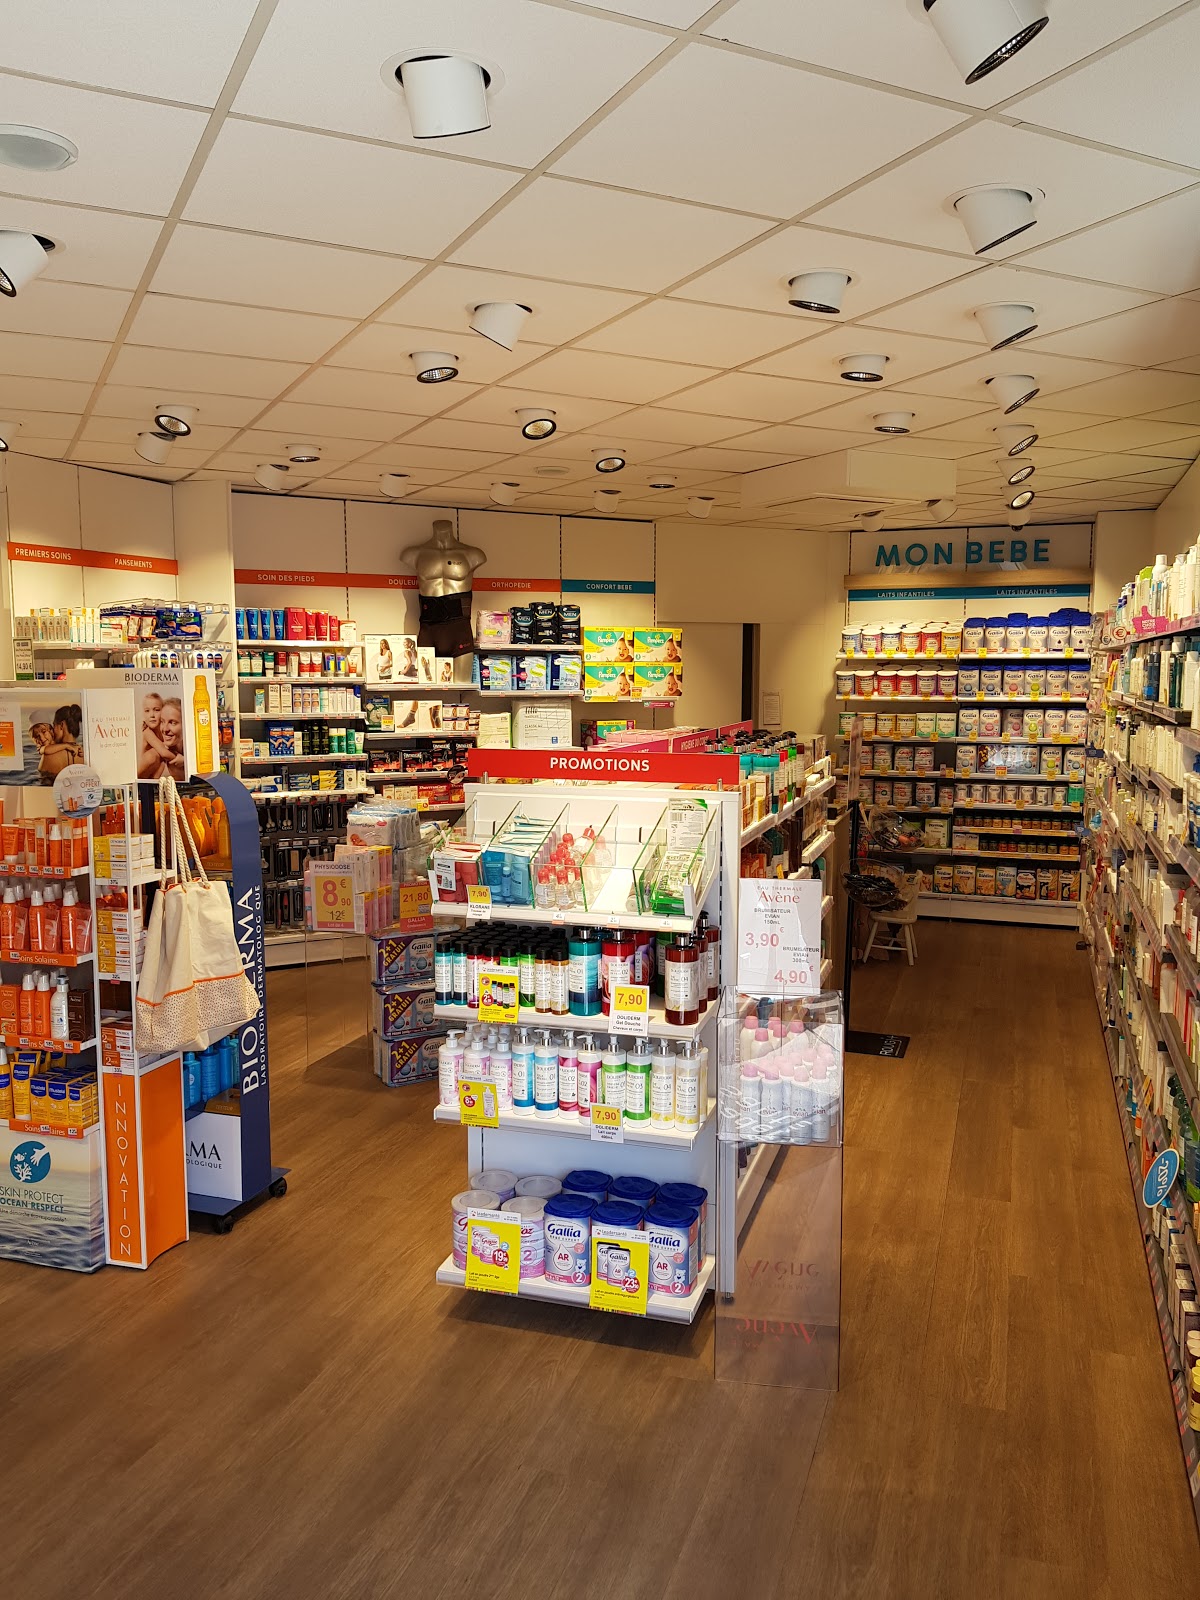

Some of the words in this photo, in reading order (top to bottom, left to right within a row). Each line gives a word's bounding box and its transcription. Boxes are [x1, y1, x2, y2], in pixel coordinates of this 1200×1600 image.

[15, 548, 49, 558] PREMIERS
[51, 551, 72, 561] SOINS
[875, 542, 952, 567] MON
[966, 539, 1050, 564] BEBE
[114, 558, 153, 569] PANSEMENTS
[257, 573, 278, 582] SOIN
[279, 574, 293, 582] DES
[294, 574, 315, 583] PIEDS
[388, 578, 418, 586] DOULEU
[491, 581, 532, 589] ORTHOPEDIE
[895, 590, 935, 598] INFANTILES
[124, 672, 179, 682] BIODERMA
[94, 724, 130, 739] Avène
[550, 757, 650, 772] PROMOTIONS
[322, 880, 339, 907] 8
[340, 879, 347, 889] €
[758, 890, 800, 904] Avène
[341, 898, 351, 906] 90
[254, 884, 264, 998] DERMATOLOGQUE
[411, 941, 432, 951] Gallia
[34, 954, 59, 964] Solaires
[383, 941, 406, 967] GRATUIT
[237, 887, 259, 1095] BIORMA
[388, 996, 412, 1022] GRATUIT
[395, 1042, 419, 1070] GRATUIT
[24, 1124, 40, 1132] Soins
[49, 1127, 66, 1136] laires
[186, 1141, 222, 1161] MA
[115, 1083, 131, 1257] INNOVATION
[0, 1185, 21, 1198] SKIN
[24, 1189, 64, 1204] PROTECT
[0, 1197, 28, 1208] OCEAN
[31, 1202, 64, 1213] RESPECT
[547, 1223, 581, 1238] Gallia
[523, 1250, 533, 1261] 2
[557, 1253, 569, 1261] AR
[609, 1252, 628, 1261] Gallia
[656, 1262, 668, 1271] AR
[575, 1274, 583, 1283] 2
[674, 1283, 682, 1293] 2
